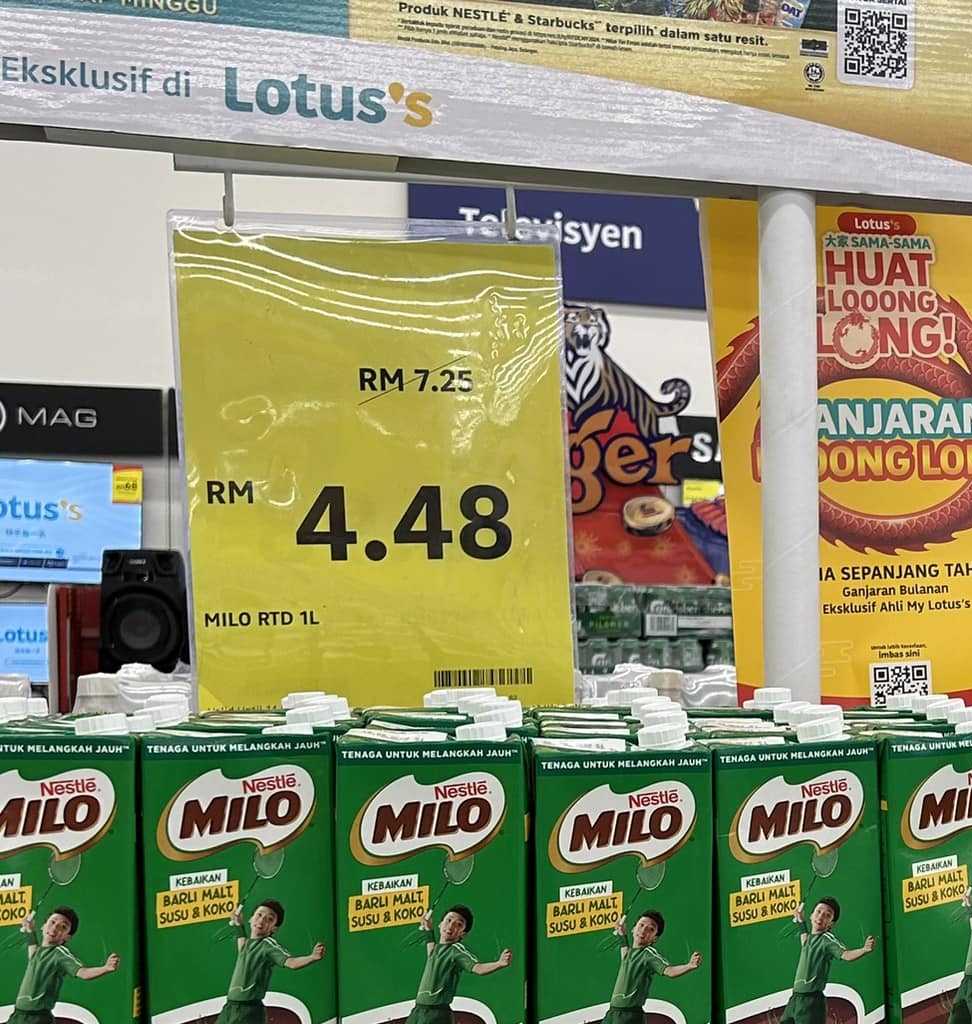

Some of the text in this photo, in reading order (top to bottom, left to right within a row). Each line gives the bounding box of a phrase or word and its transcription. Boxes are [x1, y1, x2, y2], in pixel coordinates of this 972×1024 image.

[398, 3, 449, 17] Produk
[514, 14, 524, 24] &
[660, 27, 700, 41] dalam
[704, 32, 732, 44] satu
[735, 34, 769, 47] resit.
[2, 56, 433, 128] Eksklusif di Lotus's
[459, 207, 642, 252] Televisyen
[854, 217, 900, 231] Lotus's
[851, 236, 932, 250] SAMA-SAMA
[825, 250, 933, 287] HUAT
[828, 290, 936, 313] LOOONG
[817, 314, 957, 364] LONG!
[358, 368, 474, 393] RM 7.25
[18, 406, 98, 429] MAG
[206, 480, 513, 563] RM 4.48
[841, 563, 940, 581] SEPANJANG
[842, 584, 949, 600] Ganjaran Bulanan
[823, 599, 971, 615] Eksklusif Ahli My Lotus's
[203, 610, 320, 629] MILO RTD 1L
[878, 648, 920, 659] imbas sini
[147, 744, 189, 753] TENAGA
[191, 744, 227, 753] UNTUK
[229, 742, 292, 752] MELANGKAH
[179, 790, 301, 839] MILO
[372, 796, 492, 845] MILO
[748, 793, 853, 844] MILO
[175, 873, 222, 887] KEBAIKAN
[163, 891, 197, 907] BARLI
[159, 900, 235, 925] SUSU & KOKO
